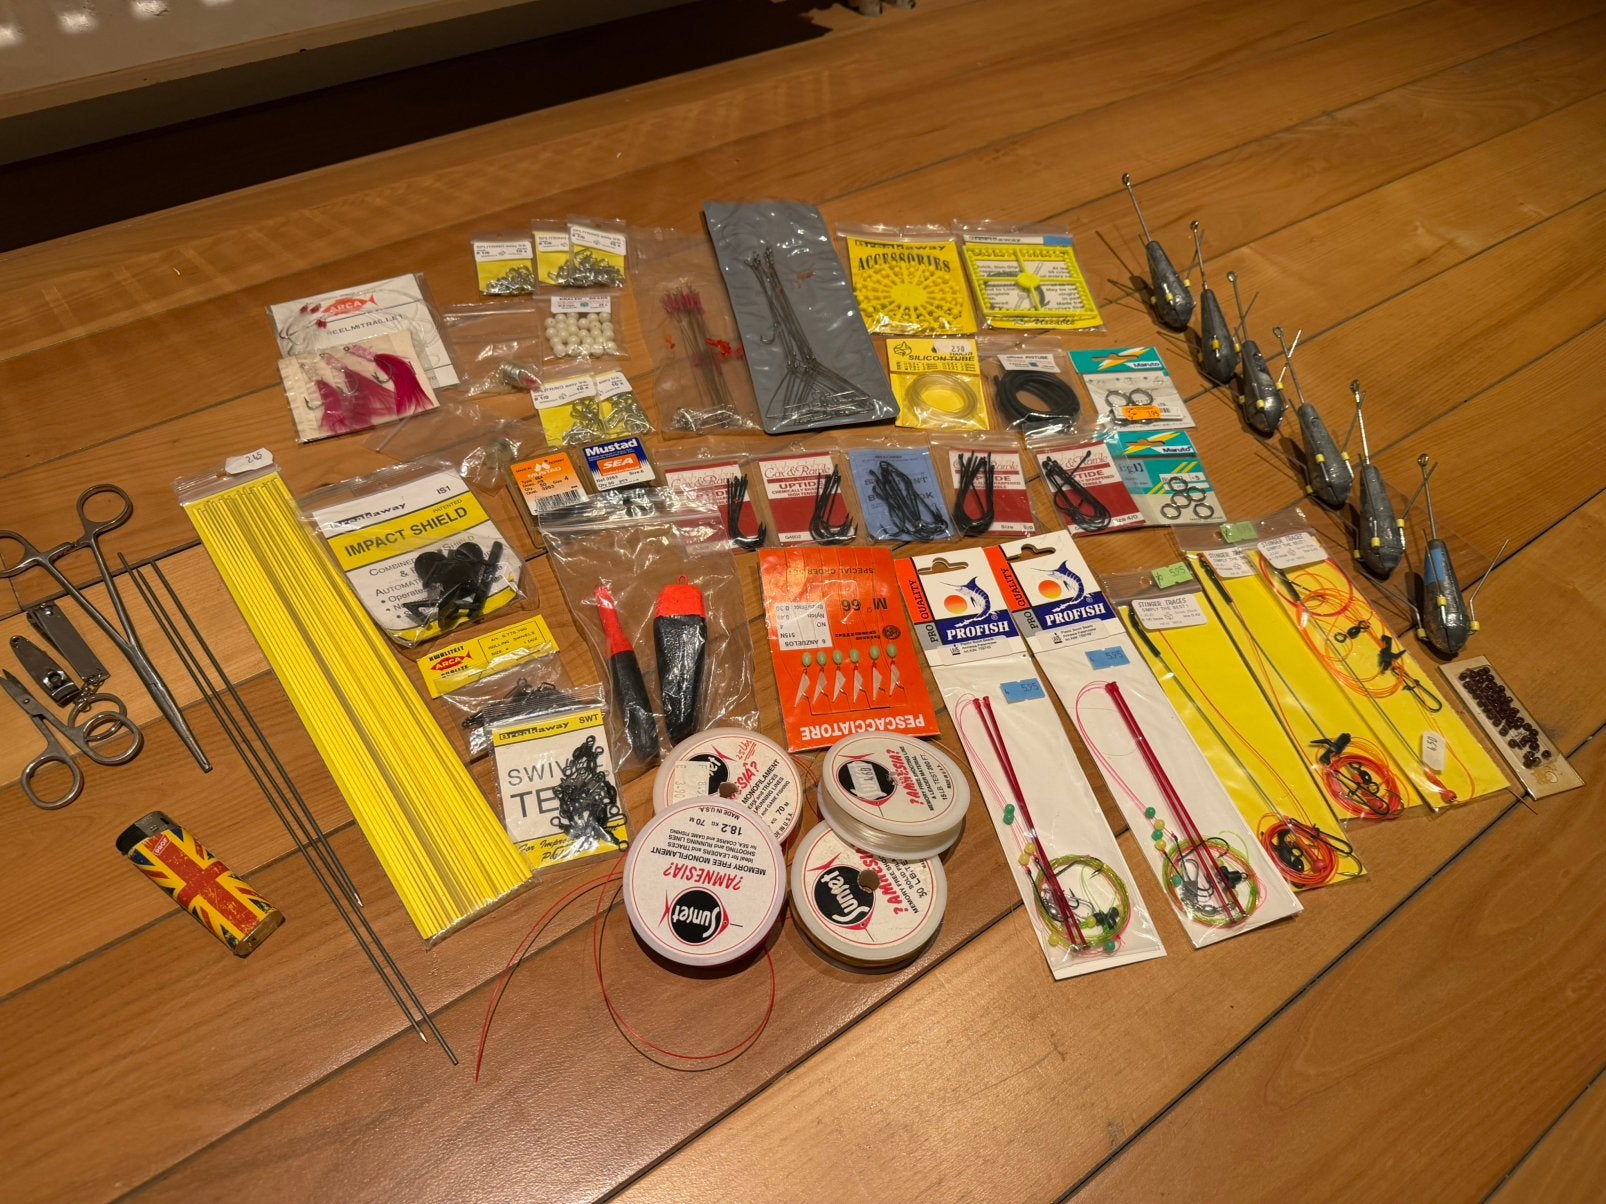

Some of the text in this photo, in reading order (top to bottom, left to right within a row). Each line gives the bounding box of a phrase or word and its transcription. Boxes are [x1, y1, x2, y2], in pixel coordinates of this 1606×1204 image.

[584, 439, 638, 456] Mustad
[603, 457, 634, 469] SEA
[778, 481, 817, 490] UPTID
[344, 507, 468, 558] IMPACT SHIELD
[1000, 567, 1026, 607] QUALITY
[841, 599, 861, 612] 66
[908, 579, 930, 620] QUALITY
[1137, 597, 1187, 608] STINGER TRACES
[1023, 611, 1040, 630] PRO
[1044, 602, 1106, 626] PROFISH
[925, 624, 939, 643] PRO
[947, 620, 1010, 641] PROFISH
[784, 639, 820, 647] ANZUELOS
[435, 657, 462, 670] ARCA
[579, 714, 598, 724] SWT
[800, 713, 926, 741] PESCACCIATORE
[741, 759, 780, 805] MONOFILAMENT
[762, 774, 778, 795] TRACES
[772, 776, 784, 793] LINES
[724, 811, 740, 820] MADE
[775, 805, 786, 815] 70
[695, 818, 705, 826] 70
[721, 823, 743, 836] 18.2
[667, 841, 692, 851] TRACES
[668, 834, 688, 843] LINES
[691, 839, 716, 849] RUNNING
[702, 848, 730, 859] LEADERS
[727, 847, 756, 857] SHOOTING
[651, 846, 766, 876] MEMORY FREE MONOFILAMENT
[663, 862, 744, 891] ?AMNESIA?
[821, 870, 870, 922] Sunset
[892, 874, 919, 914] MEMORY FREE
[672, 905, 720, 938] Sunset
